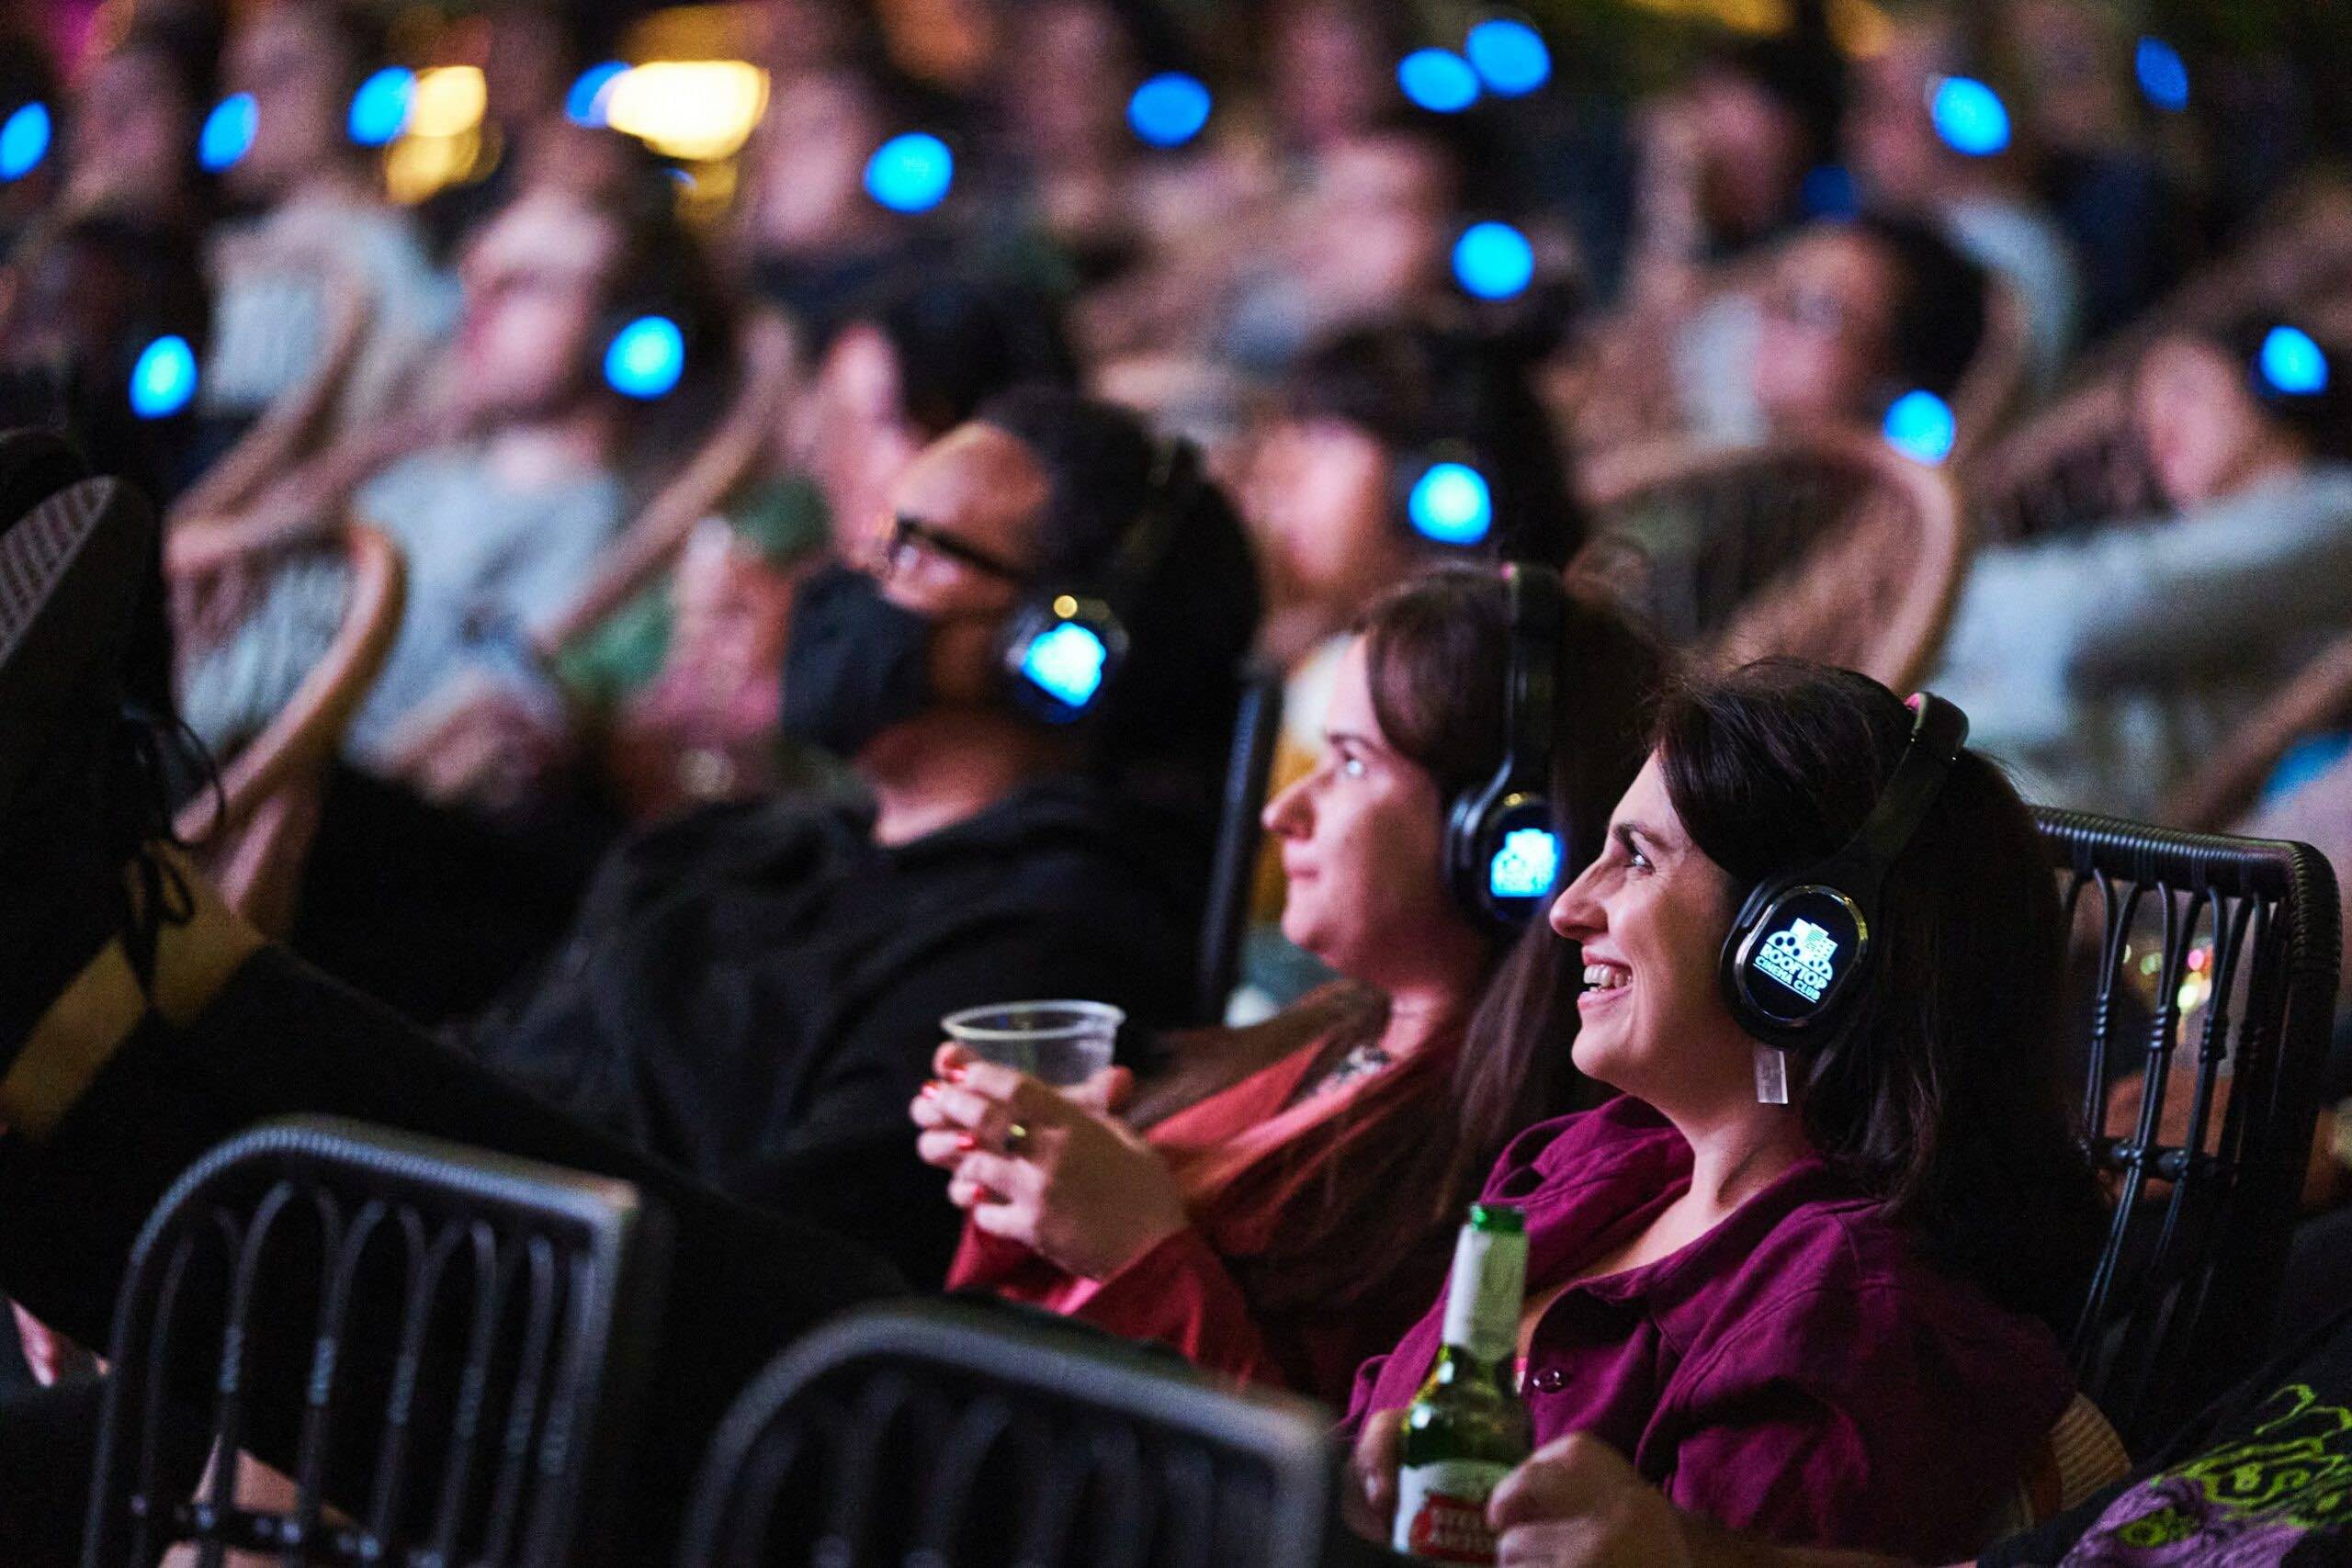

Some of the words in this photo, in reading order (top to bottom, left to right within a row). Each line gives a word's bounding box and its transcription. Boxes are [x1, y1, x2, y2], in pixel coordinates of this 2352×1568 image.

[1755, 956, 1792, 984] CINEMA
[1793, 980, 1821, 1000] CLUB
[1759, 942, 1827, 989] ROOFTOP
